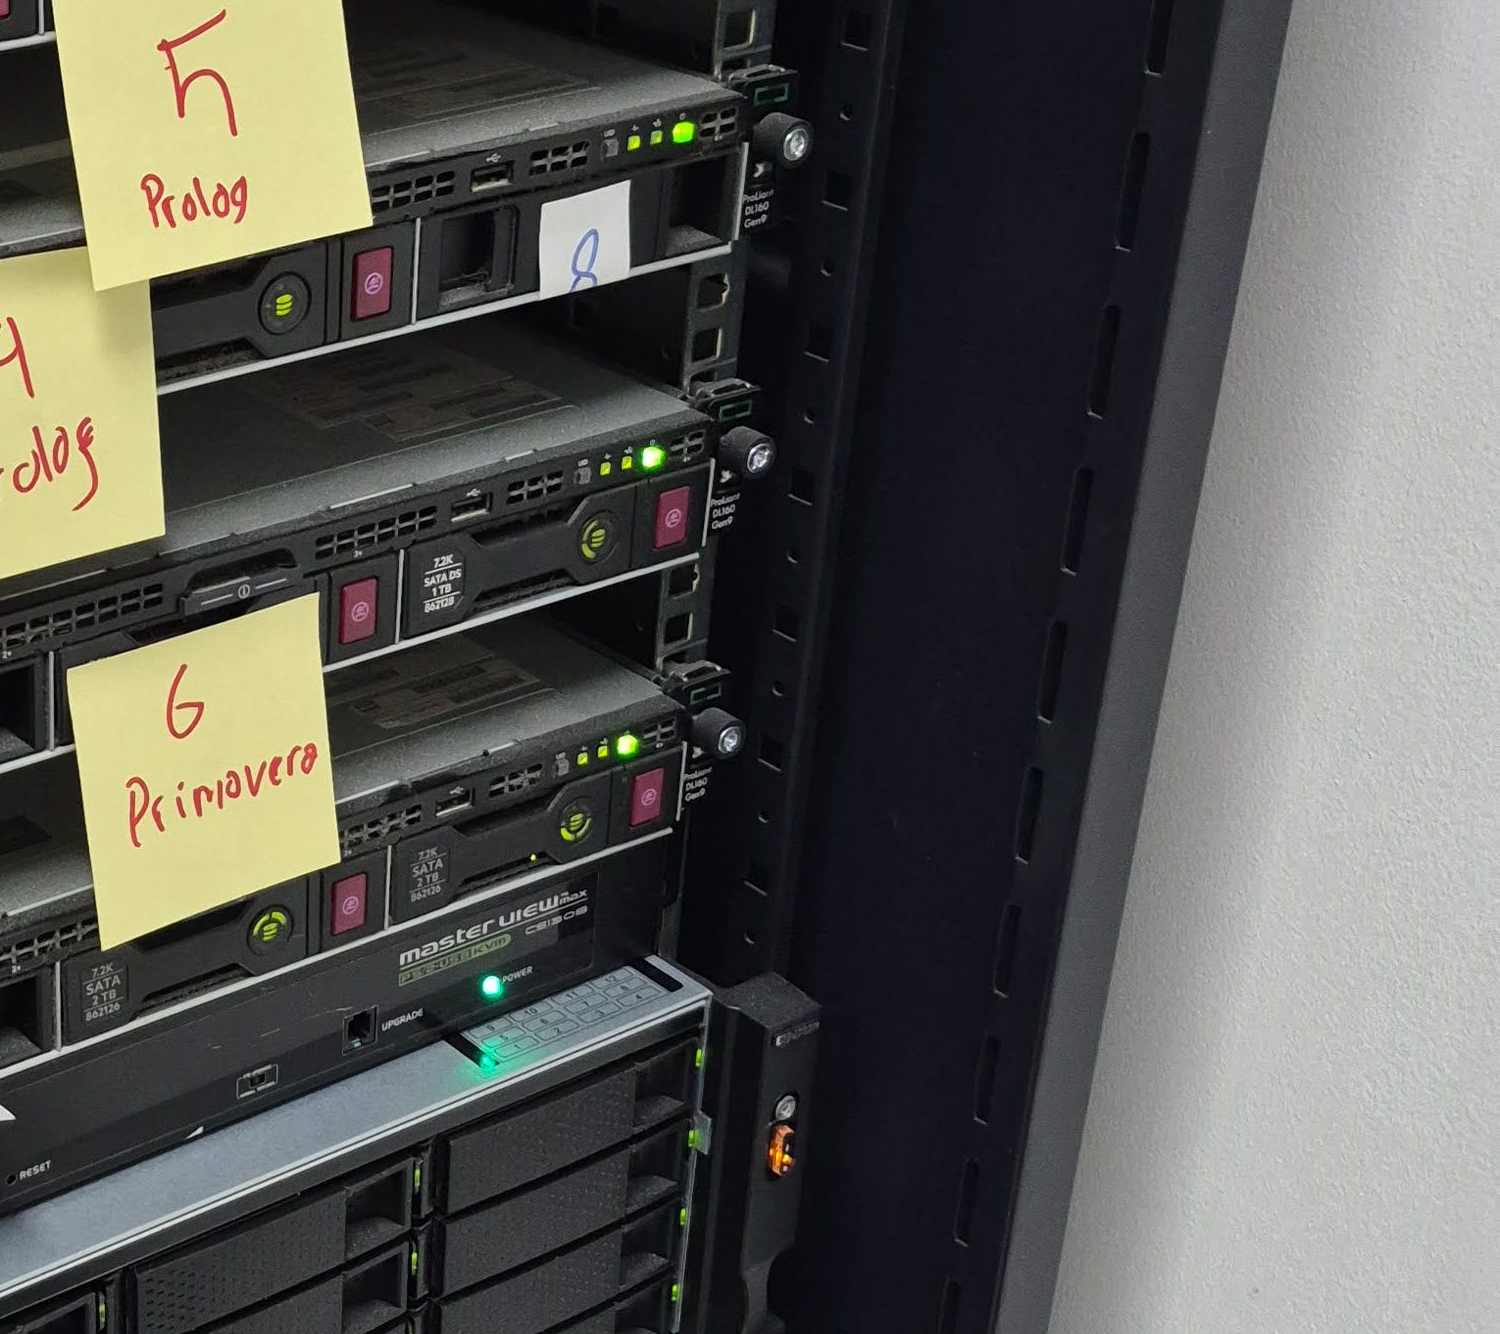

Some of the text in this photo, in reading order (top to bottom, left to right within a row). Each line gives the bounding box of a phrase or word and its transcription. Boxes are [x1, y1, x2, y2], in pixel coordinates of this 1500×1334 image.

[140, 173, 249, 229] Prolog
[744, 201, 770, 216] DL160
[743, 214, 768, 229] Gen9
[423, 568, 462, 587] SATA DS
[431, 583, 452, 597] 1 TB
[412, 858, 444, 878] SATA
[416, 871, 439, 888] 2 TB
[91, 962, 114, 978] 7.2K
[502, 965, 533, 984] POWER
[85, 975, 121, 996] SATA
[603, 974, 617, 984] 12
[92, 989, 117, 1006] 2 TB
[565, 991, 579, 1000] 11
[635, 993, 642, 1001] 4
[85, 1002, 121, 1022] 862126
[381, 1007, 425, 1032] UPGRADE
[524, 1007, 538, 1017] 10
[19, 1159, 52, 1180] RESET
